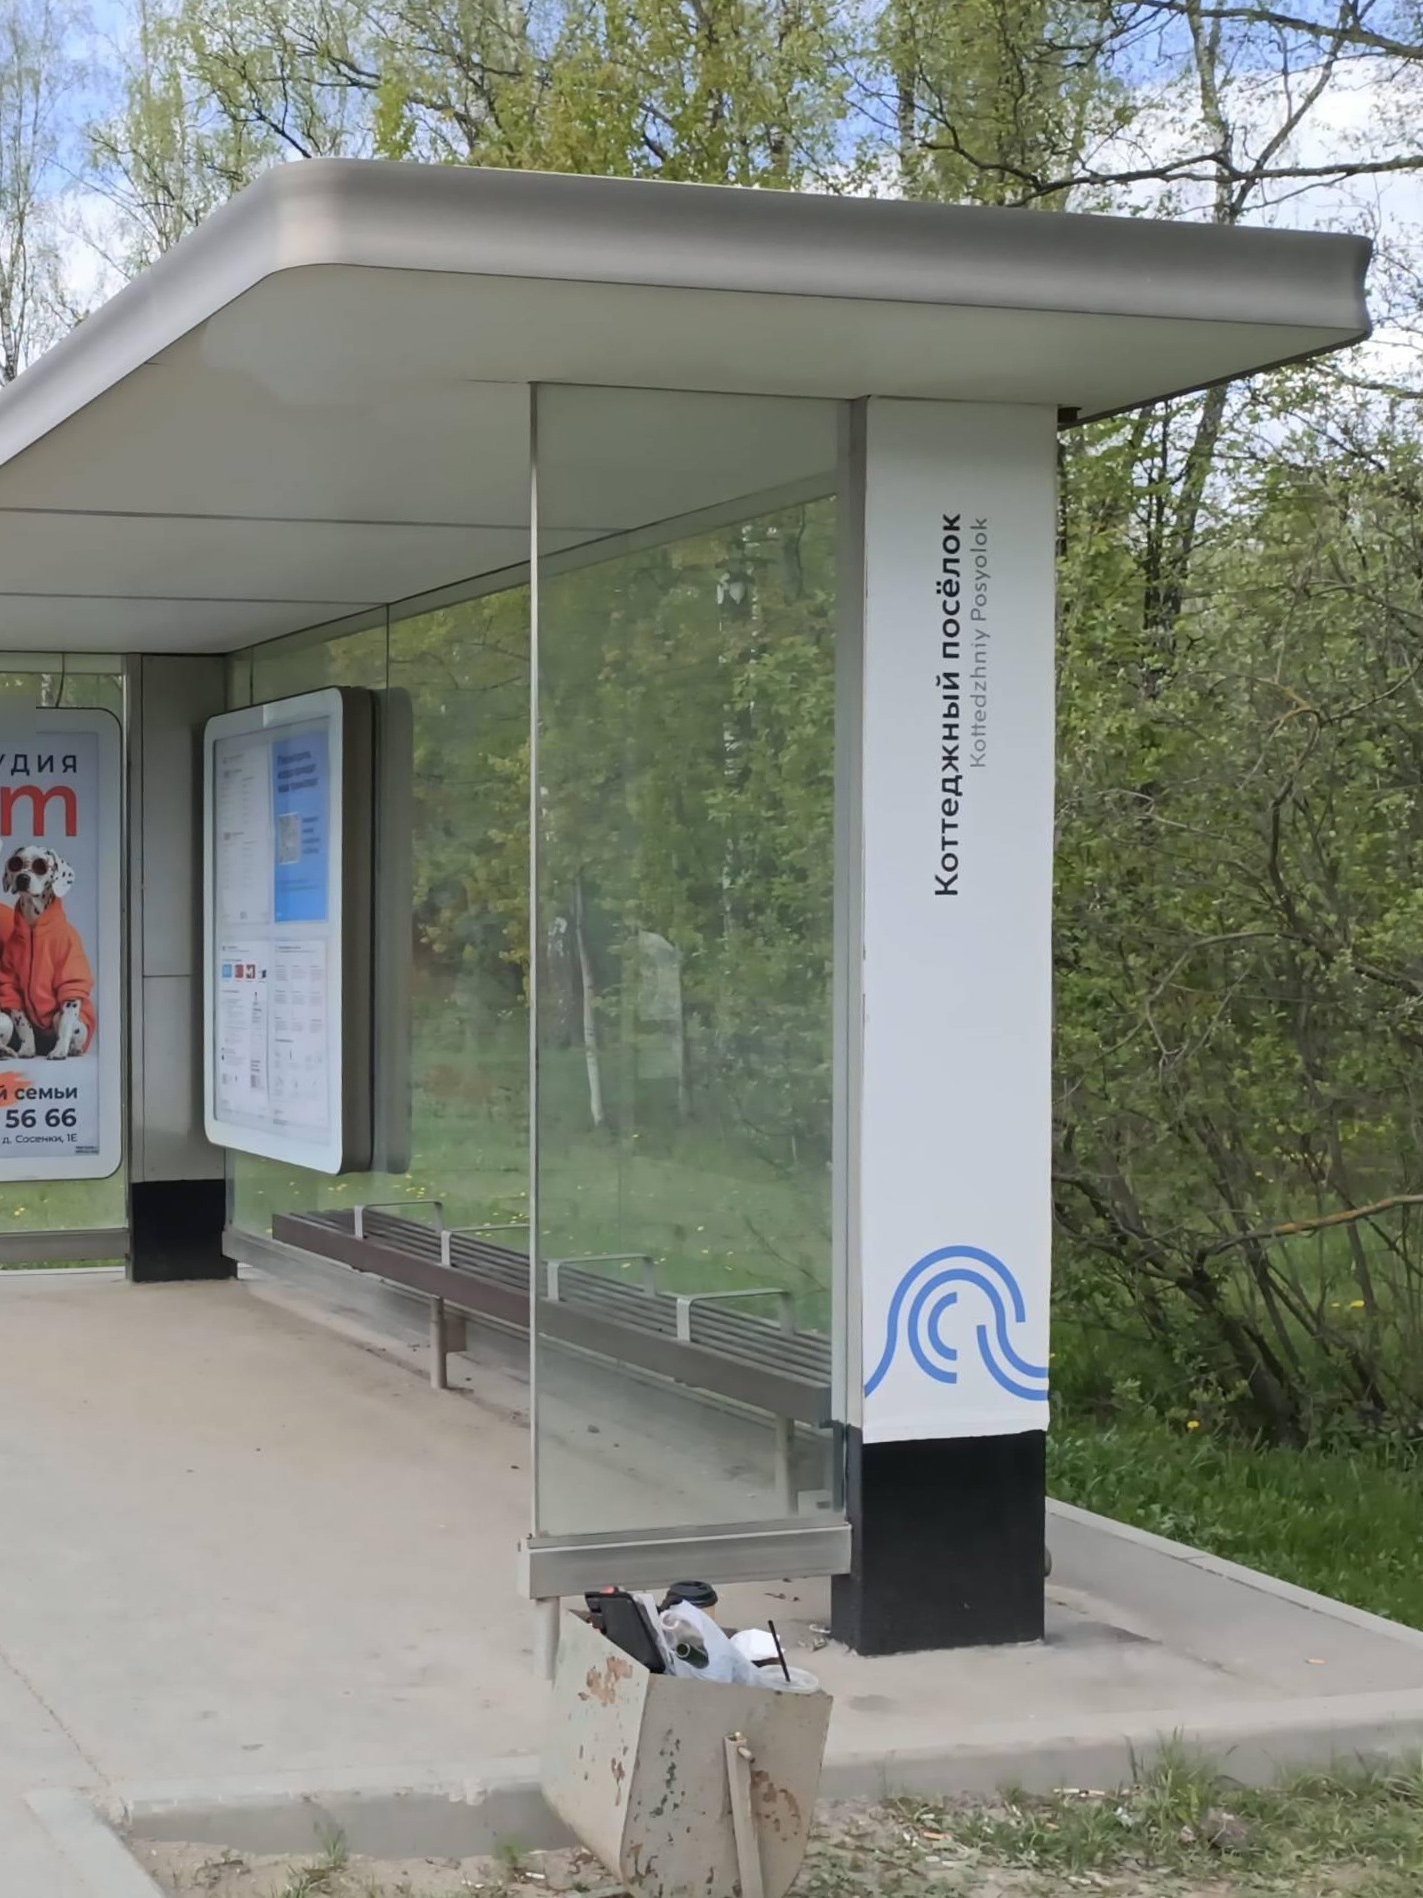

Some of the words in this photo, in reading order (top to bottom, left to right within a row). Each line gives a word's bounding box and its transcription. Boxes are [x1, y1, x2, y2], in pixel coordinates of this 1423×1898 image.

[934, 512, 963, 661] посёлок
[968, 516, 991, 623] Posyolok
[968, 630, 992, 769] Kottedzhniy
[933, 672, 964, 898] Коттеджный
[5, 1109, 37, 1129] 56
[44, 1108, 78, 1128] 66
[14, 1086, 78, 1101] семьи
[15, 1133, 64, 1144] Сосенки,
